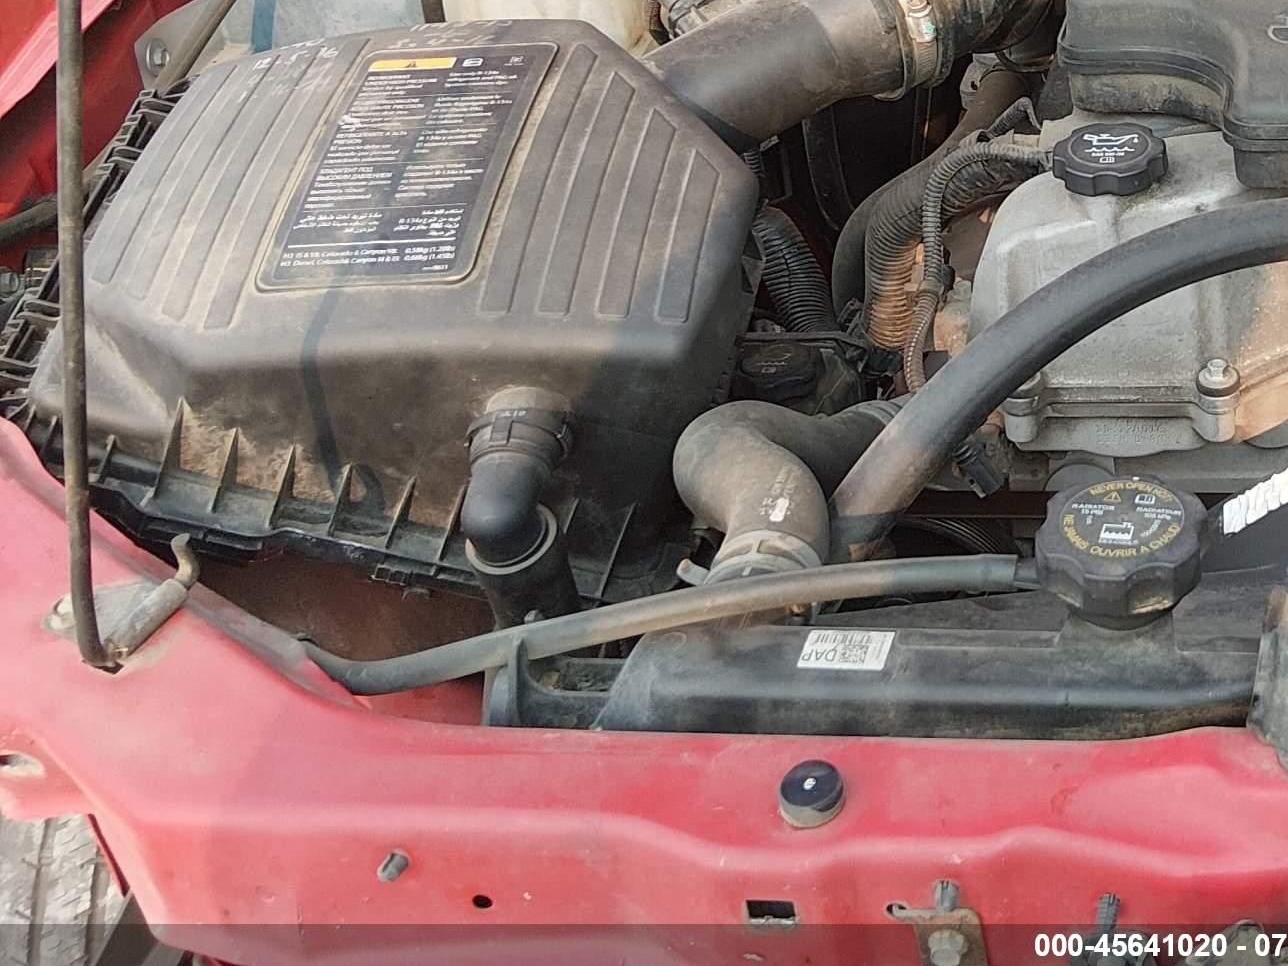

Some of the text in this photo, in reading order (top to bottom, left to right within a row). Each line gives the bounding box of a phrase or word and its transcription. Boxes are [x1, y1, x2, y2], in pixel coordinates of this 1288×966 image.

[1089, 481, 1125, 496] NEVER
[1127, 481, 1152, 493] OPEN
[1089, 545, 1137, 557] OUVRIR
[801, 648, 838, 662] DAP
